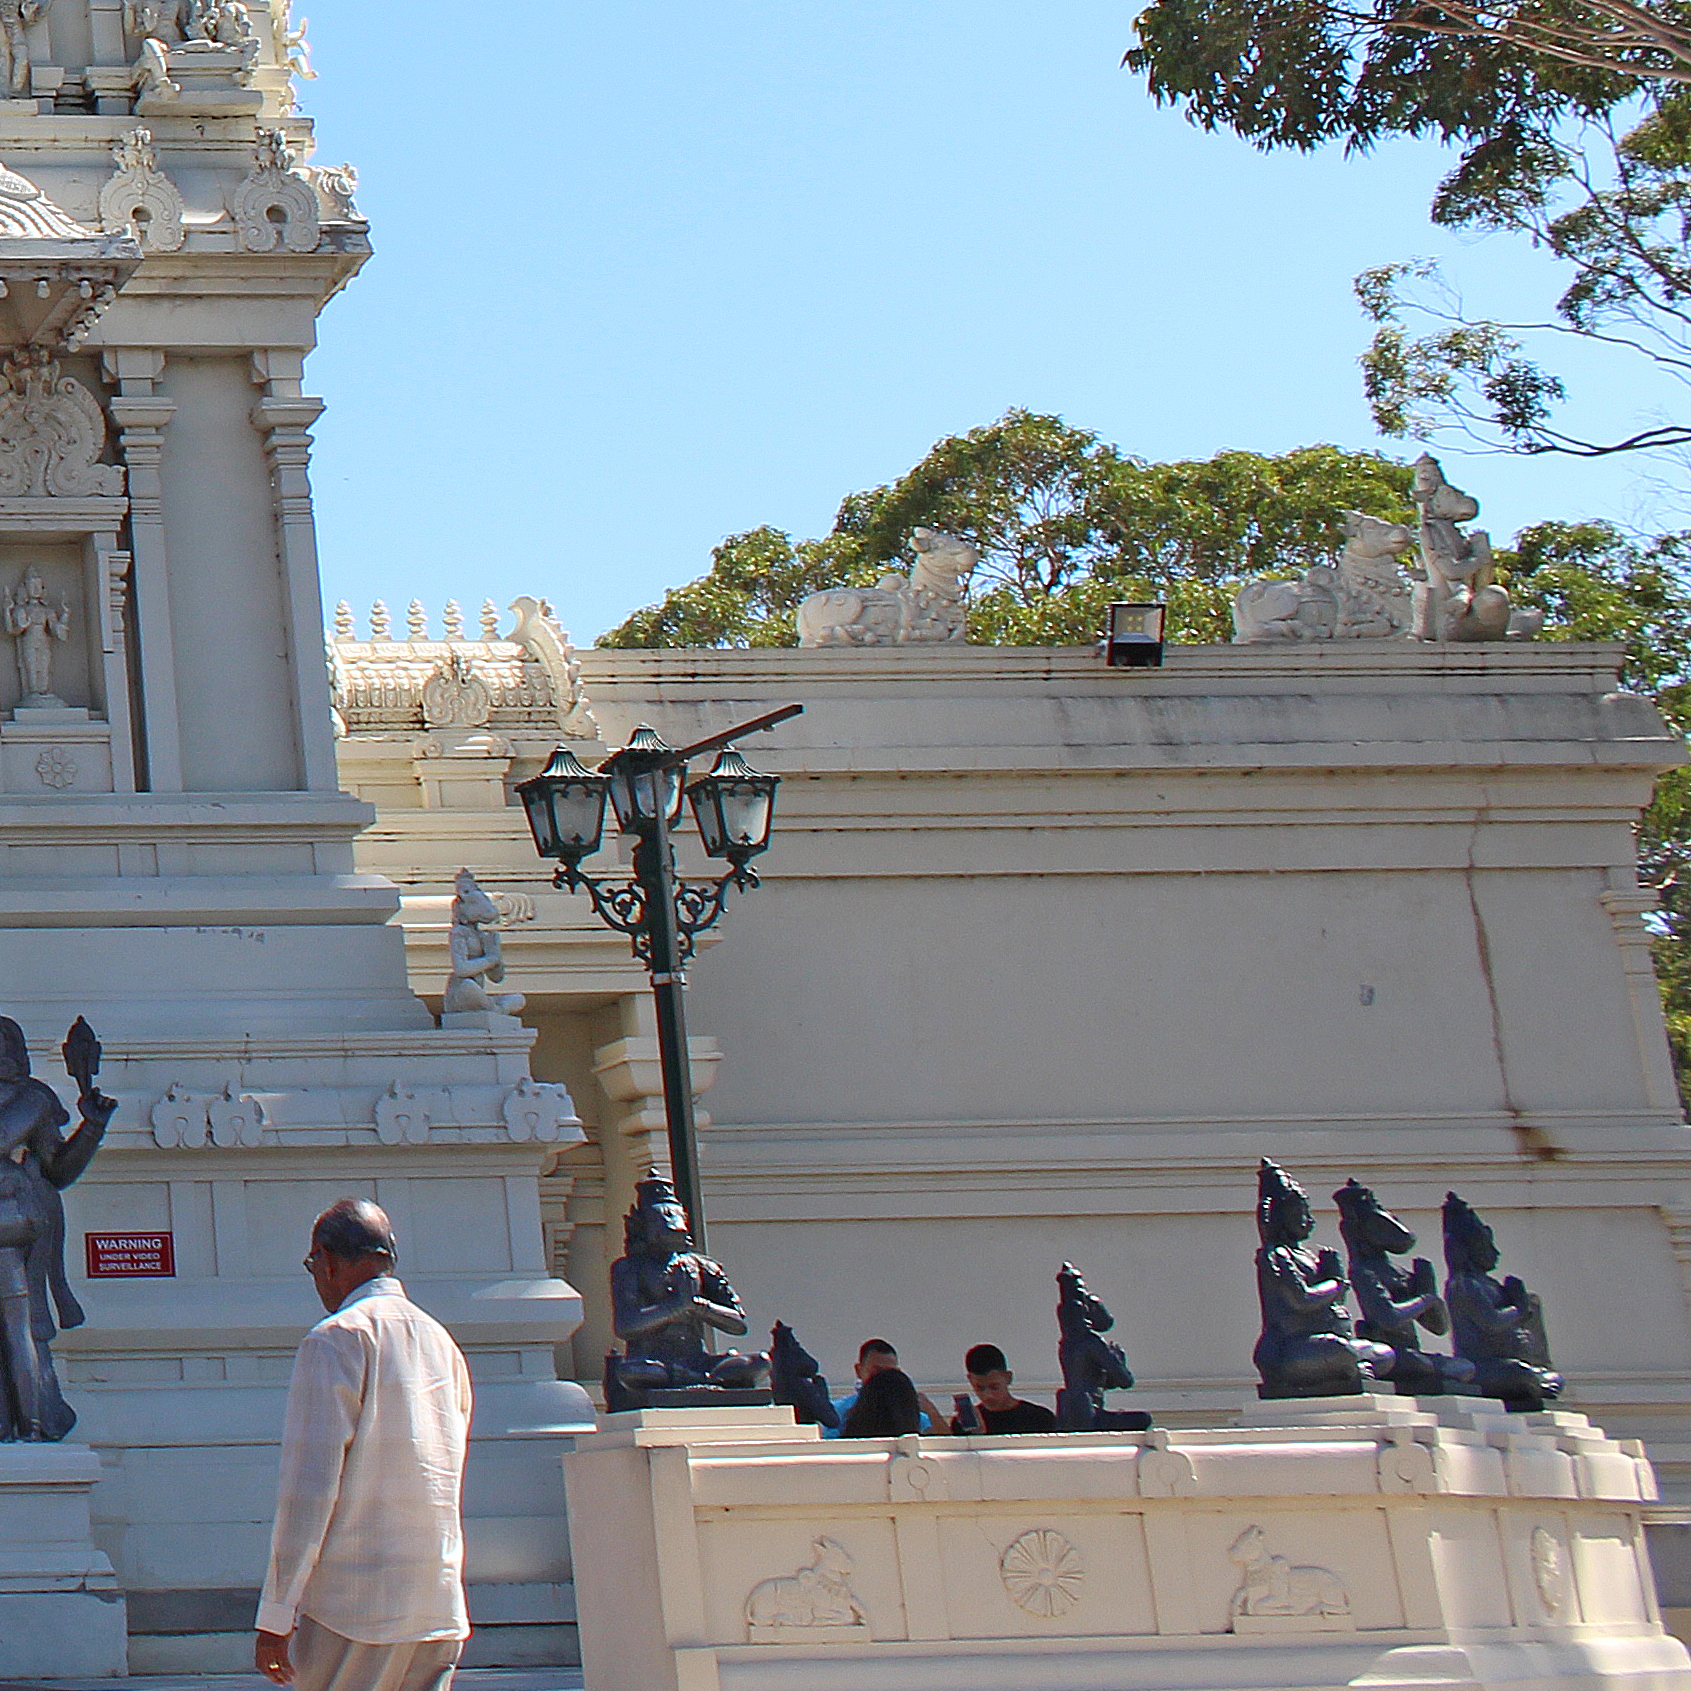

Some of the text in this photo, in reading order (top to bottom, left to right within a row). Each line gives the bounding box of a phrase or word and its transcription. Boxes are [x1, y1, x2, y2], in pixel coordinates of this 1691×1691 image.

[96, 1238, 162, 1249] WARNING
[99, 1252, 160, 1261] UNDER VIDEO
[99, 1261, 161, 1270] SURVEILLANCE
